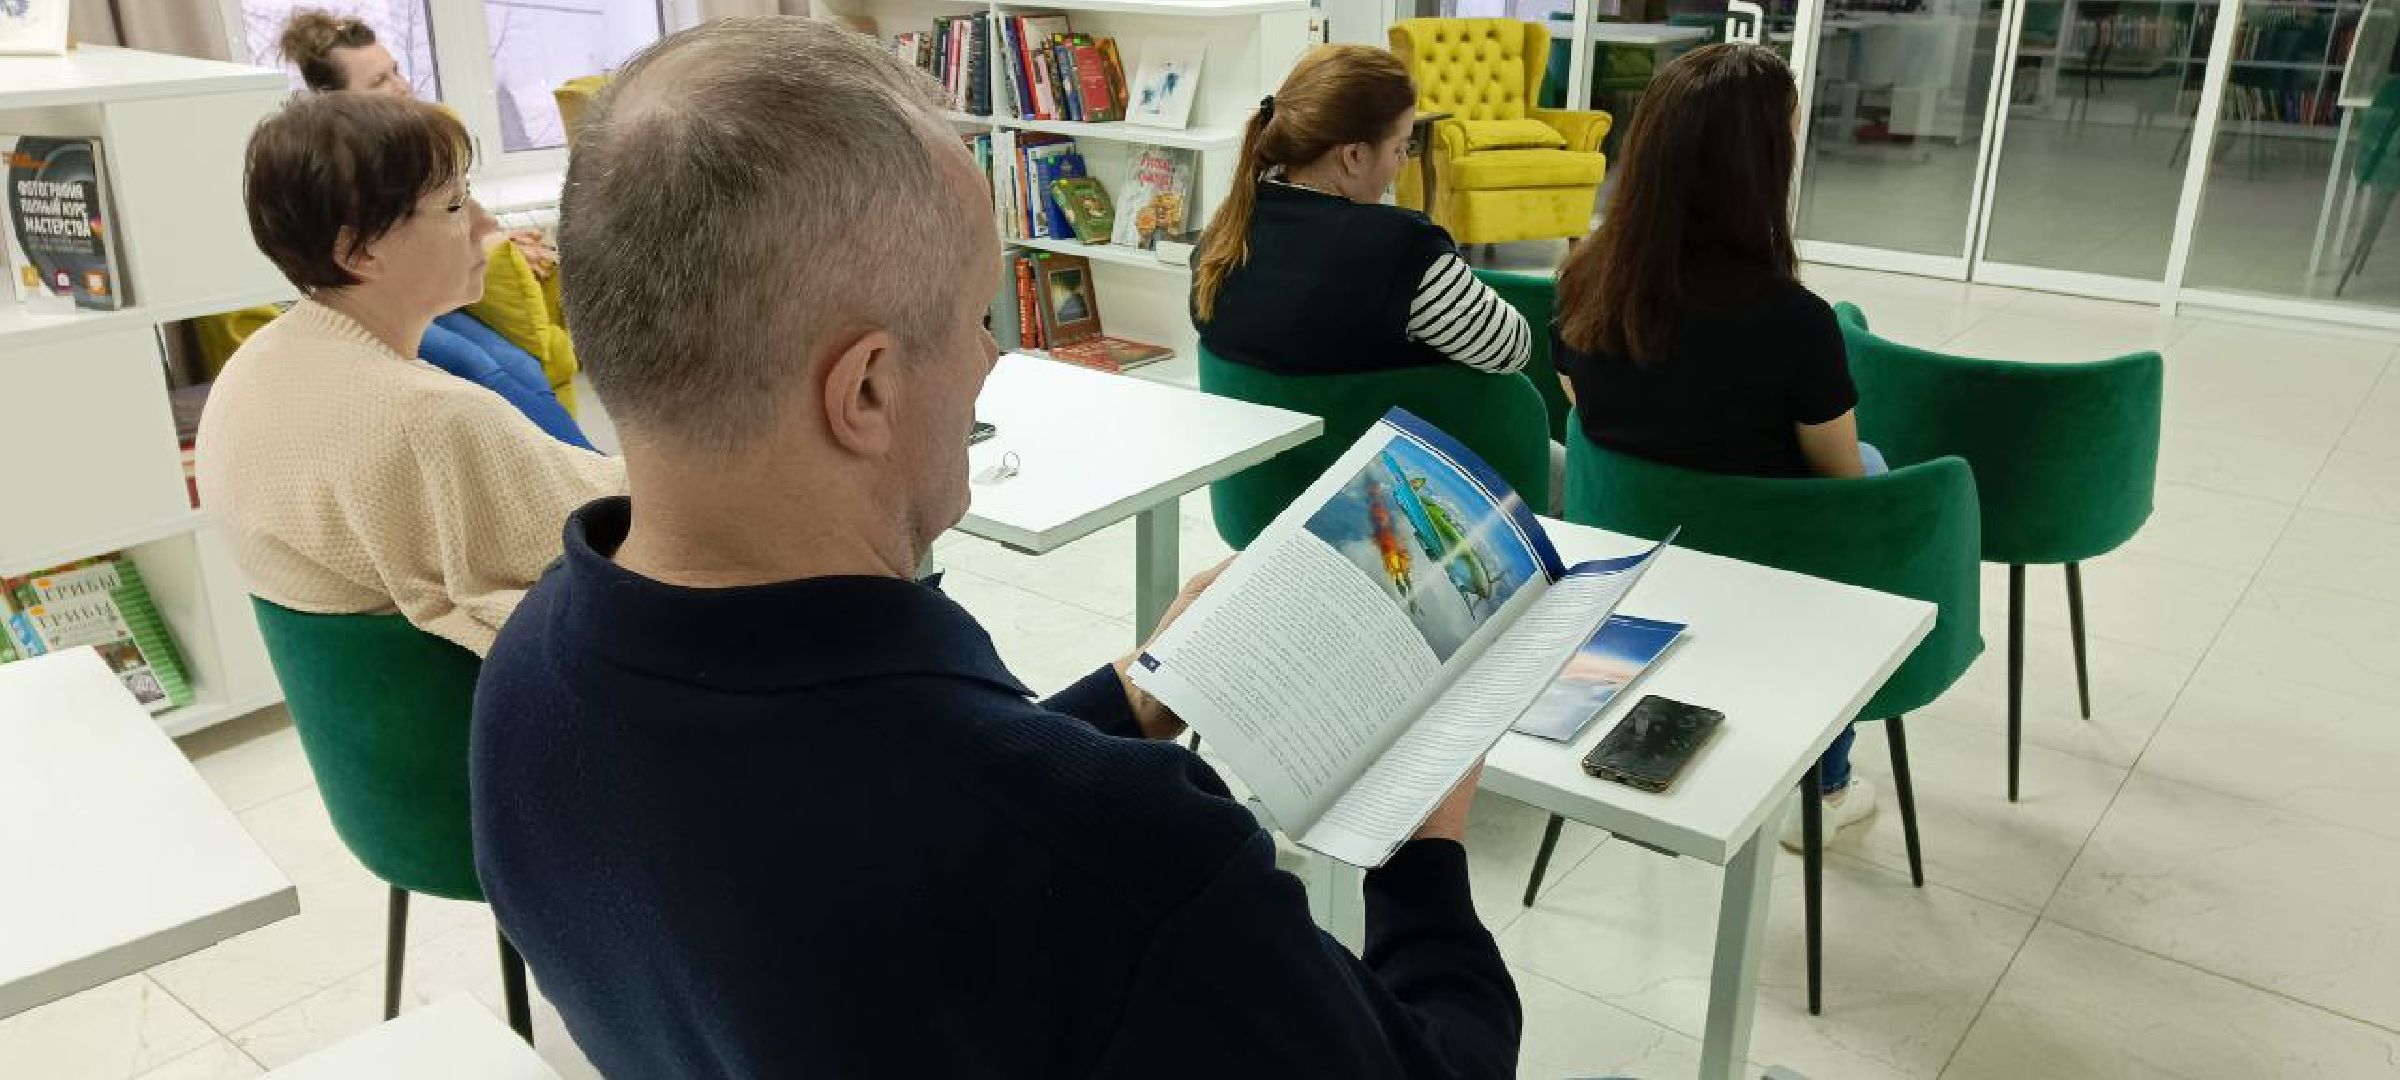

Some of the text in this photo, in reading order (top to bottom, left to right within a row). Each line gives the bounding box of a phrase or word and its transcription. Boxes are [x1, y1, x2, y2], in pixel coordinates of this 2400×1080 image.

[18, 180, 84, 199] ФОТОГРАФИЯ
[20, 198, 87, 219] ПОЛНЫЙ КУРС
[24, 214, 91, 237] МАСТЕРСТВА
